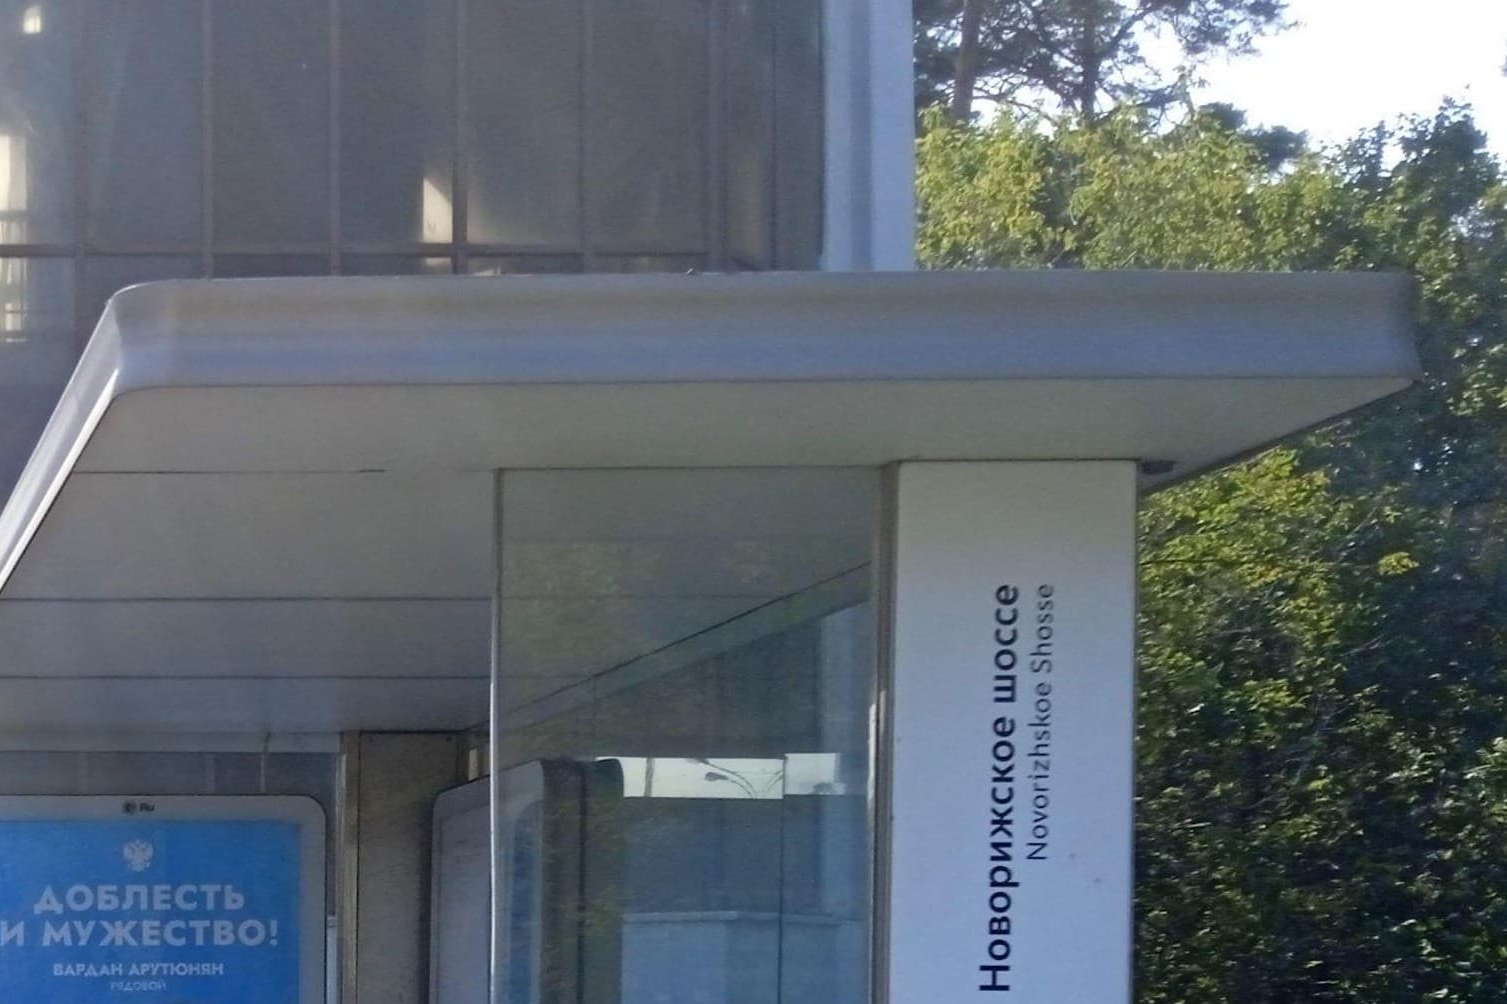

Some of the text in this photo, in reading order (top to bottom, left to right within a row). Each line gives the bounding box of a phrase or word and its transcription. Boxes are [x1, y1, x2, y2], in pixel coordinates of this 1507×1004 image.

[1026, 583, 1055, 861] Novorizhskoe Shosse
[978, 583, 1020, 992] Новорижское шоссе
[32, 884, 246, 915] ДОБЛЕСТЬ
[0, 919, 279, 947] И МУЖЕСТВО!
[52, 962, 225, 977] ВАРДАН АРУТЮНЯН
[109, 979, 167, 992] РЯДОВОЙ
